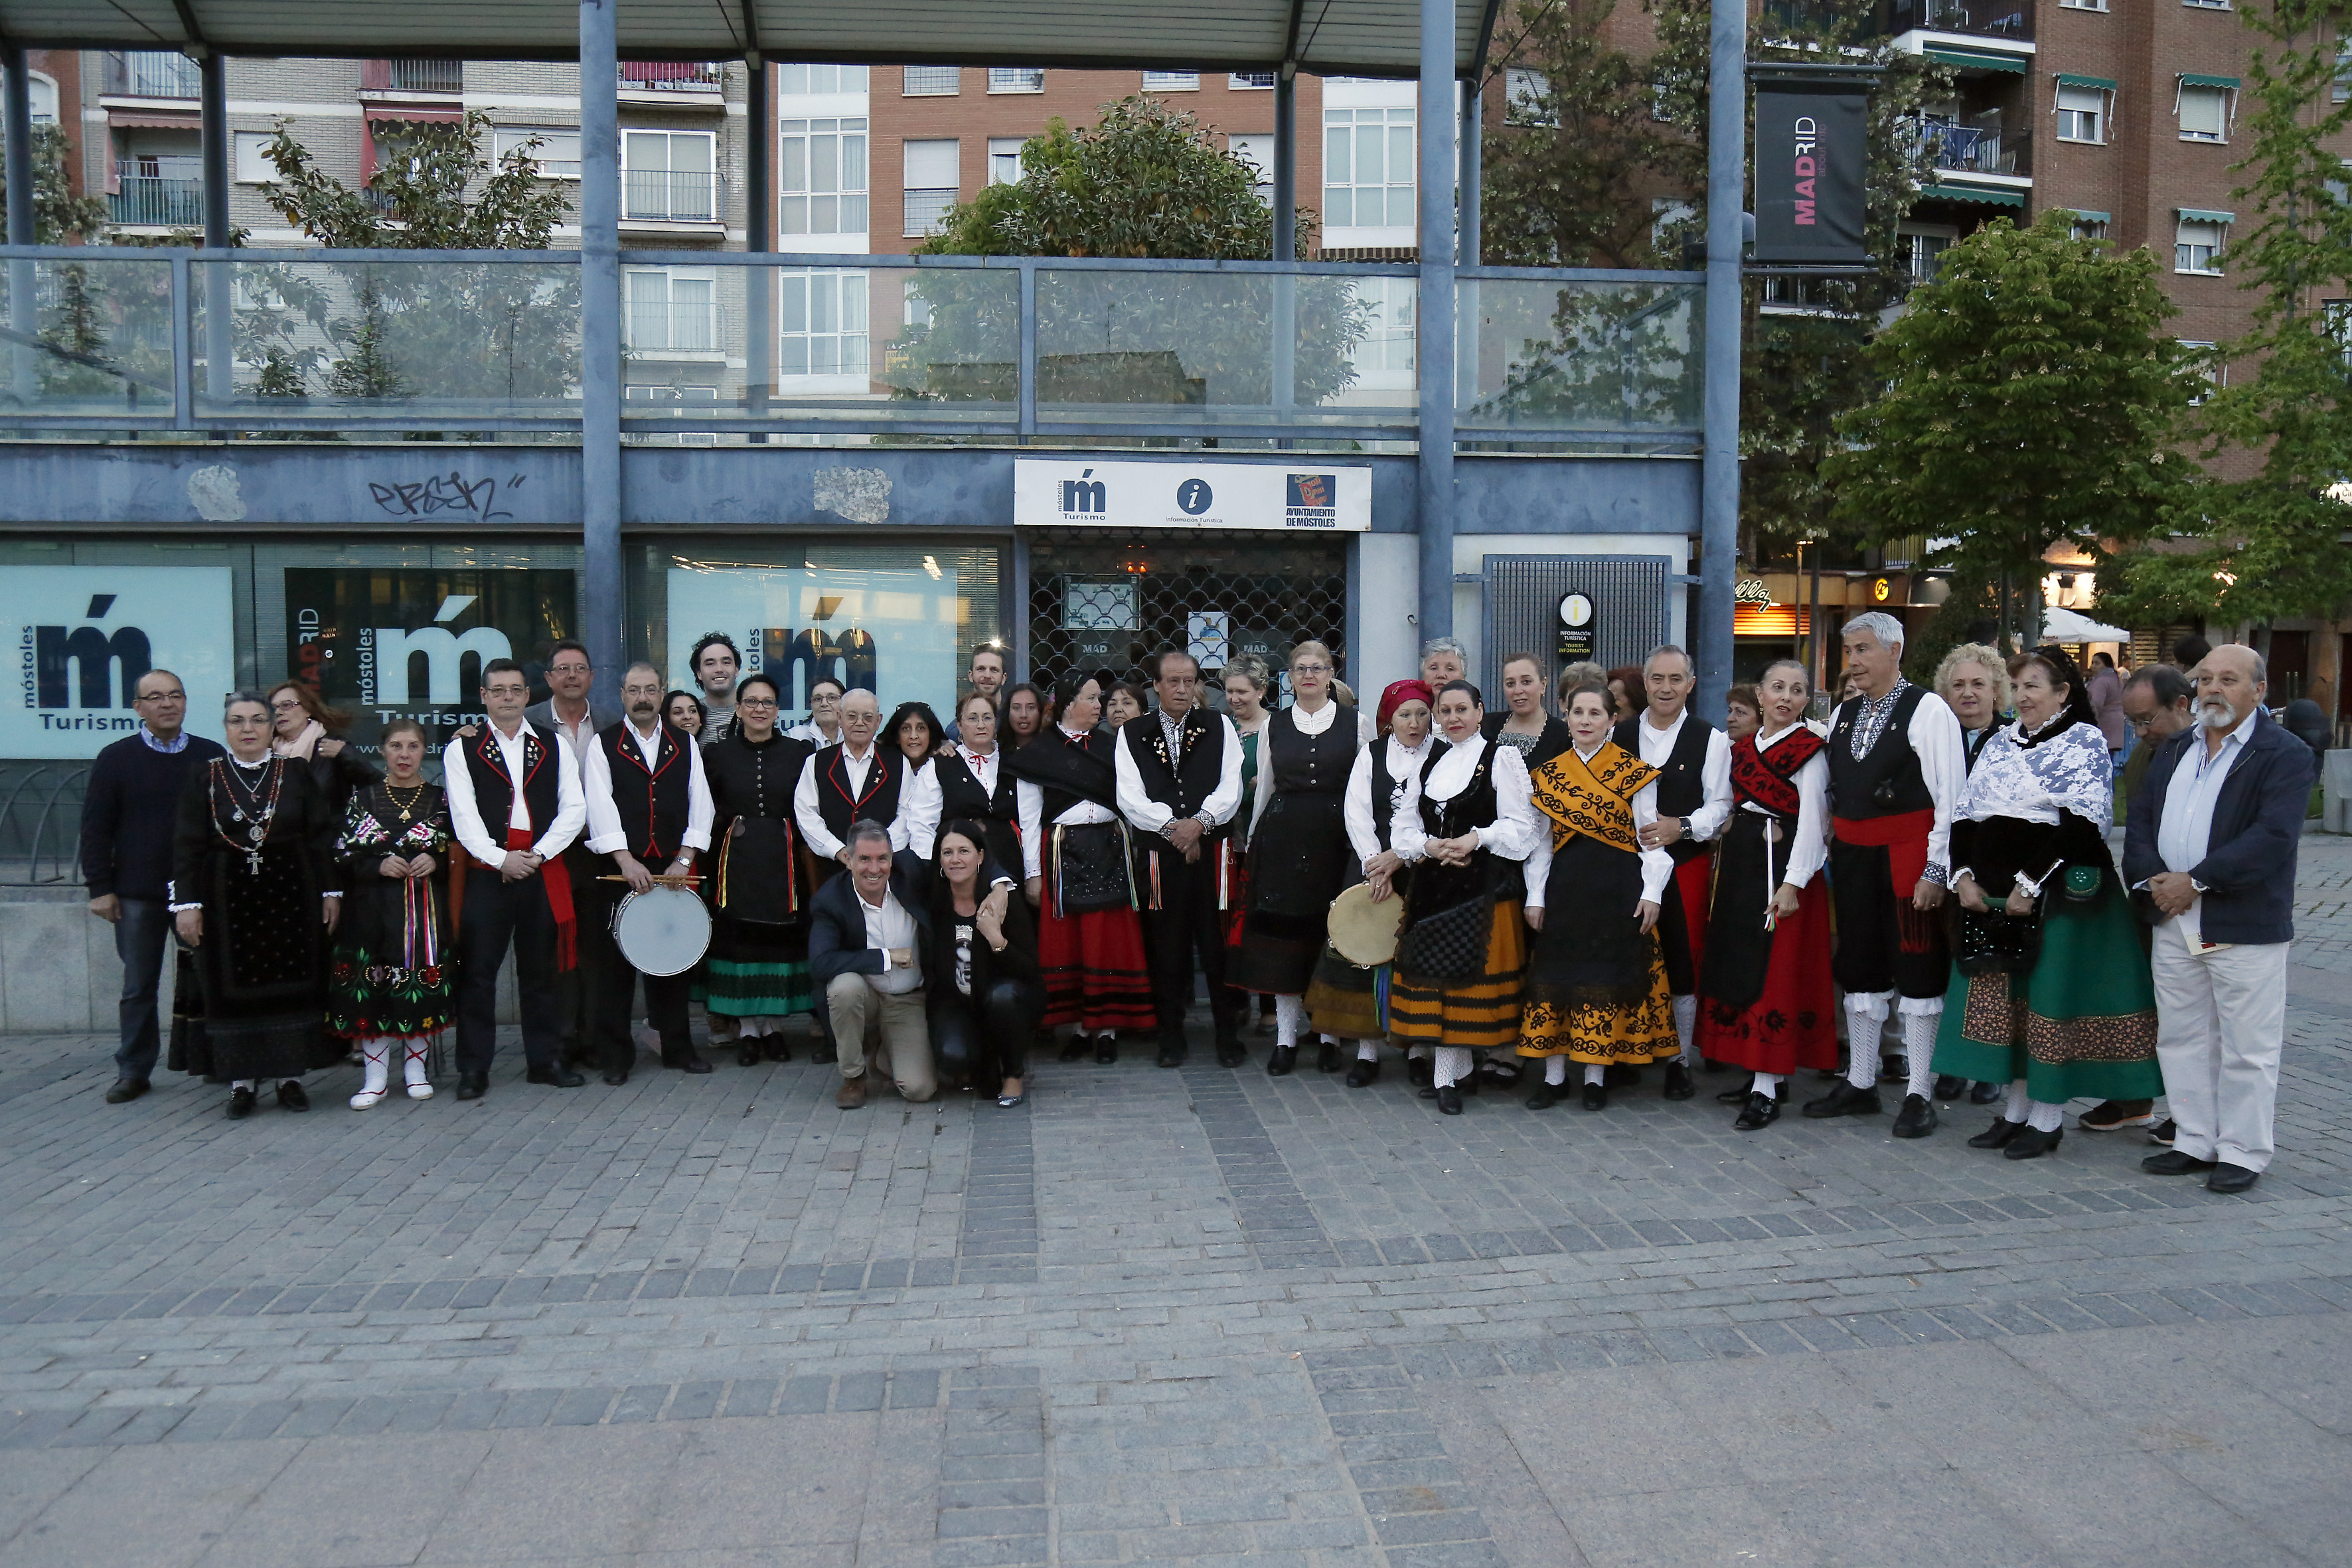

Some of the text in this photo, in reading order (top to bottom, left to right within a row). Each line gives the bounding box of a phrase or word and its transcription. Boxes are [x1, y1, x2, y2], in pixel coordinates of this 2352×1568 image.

[1795, 116, 1816, 225] MADRID
[1818, 123, 1826, 177] about info
[1286, 508, 1336, 517] AYUNTAMIENTO
[1287, 516, 1336, 527] DE MÓSTOLES
[20, 625, 35, 708] móstoles
[299, 608, 321, 691] ADRID
[356, 628, 374, 706] móstoles
[746, 628, 760, 673] toles
[375, 710, 489, 726] Trism
